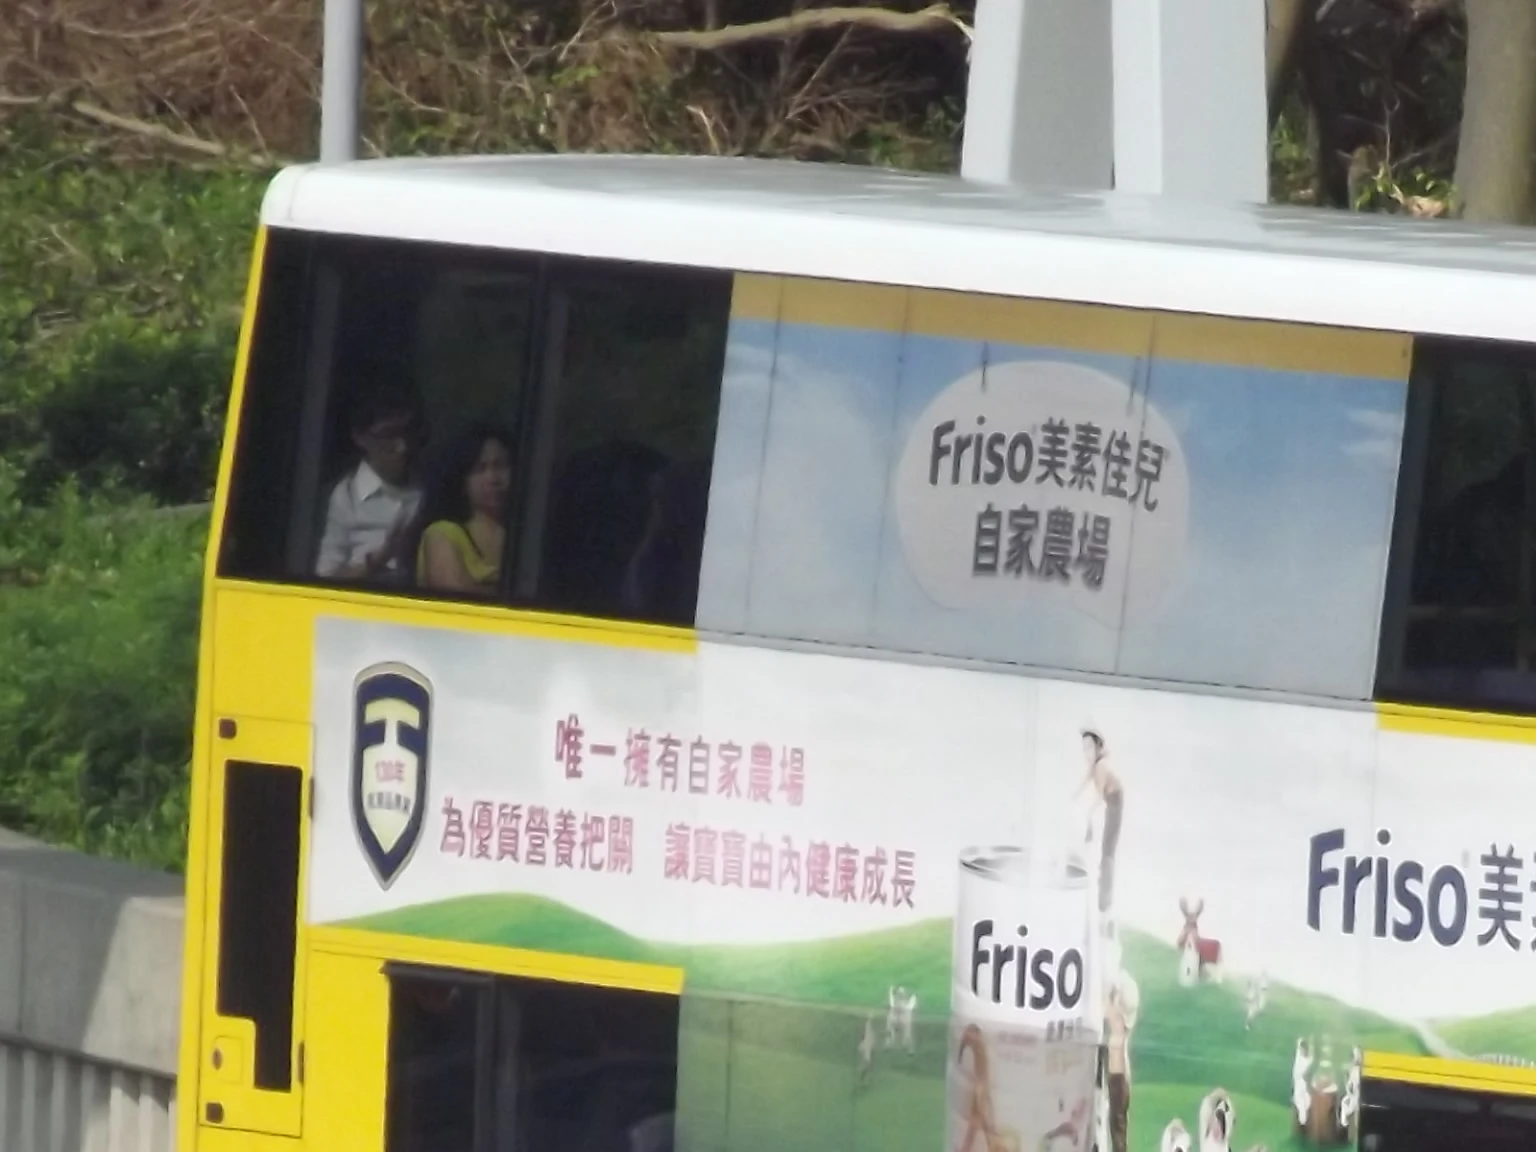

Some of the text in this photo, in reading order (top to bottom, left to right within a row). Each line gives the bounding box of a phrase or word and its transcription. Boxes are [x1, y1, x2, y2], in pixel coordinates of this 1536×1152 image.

[928, 415, 1165, 512] Friso 美素佳兒
[972, 502, 1111, 590] 自家農場
[1306, 828, 1468, 947] Friso
[971, 919, 1084, 1011] Friso
